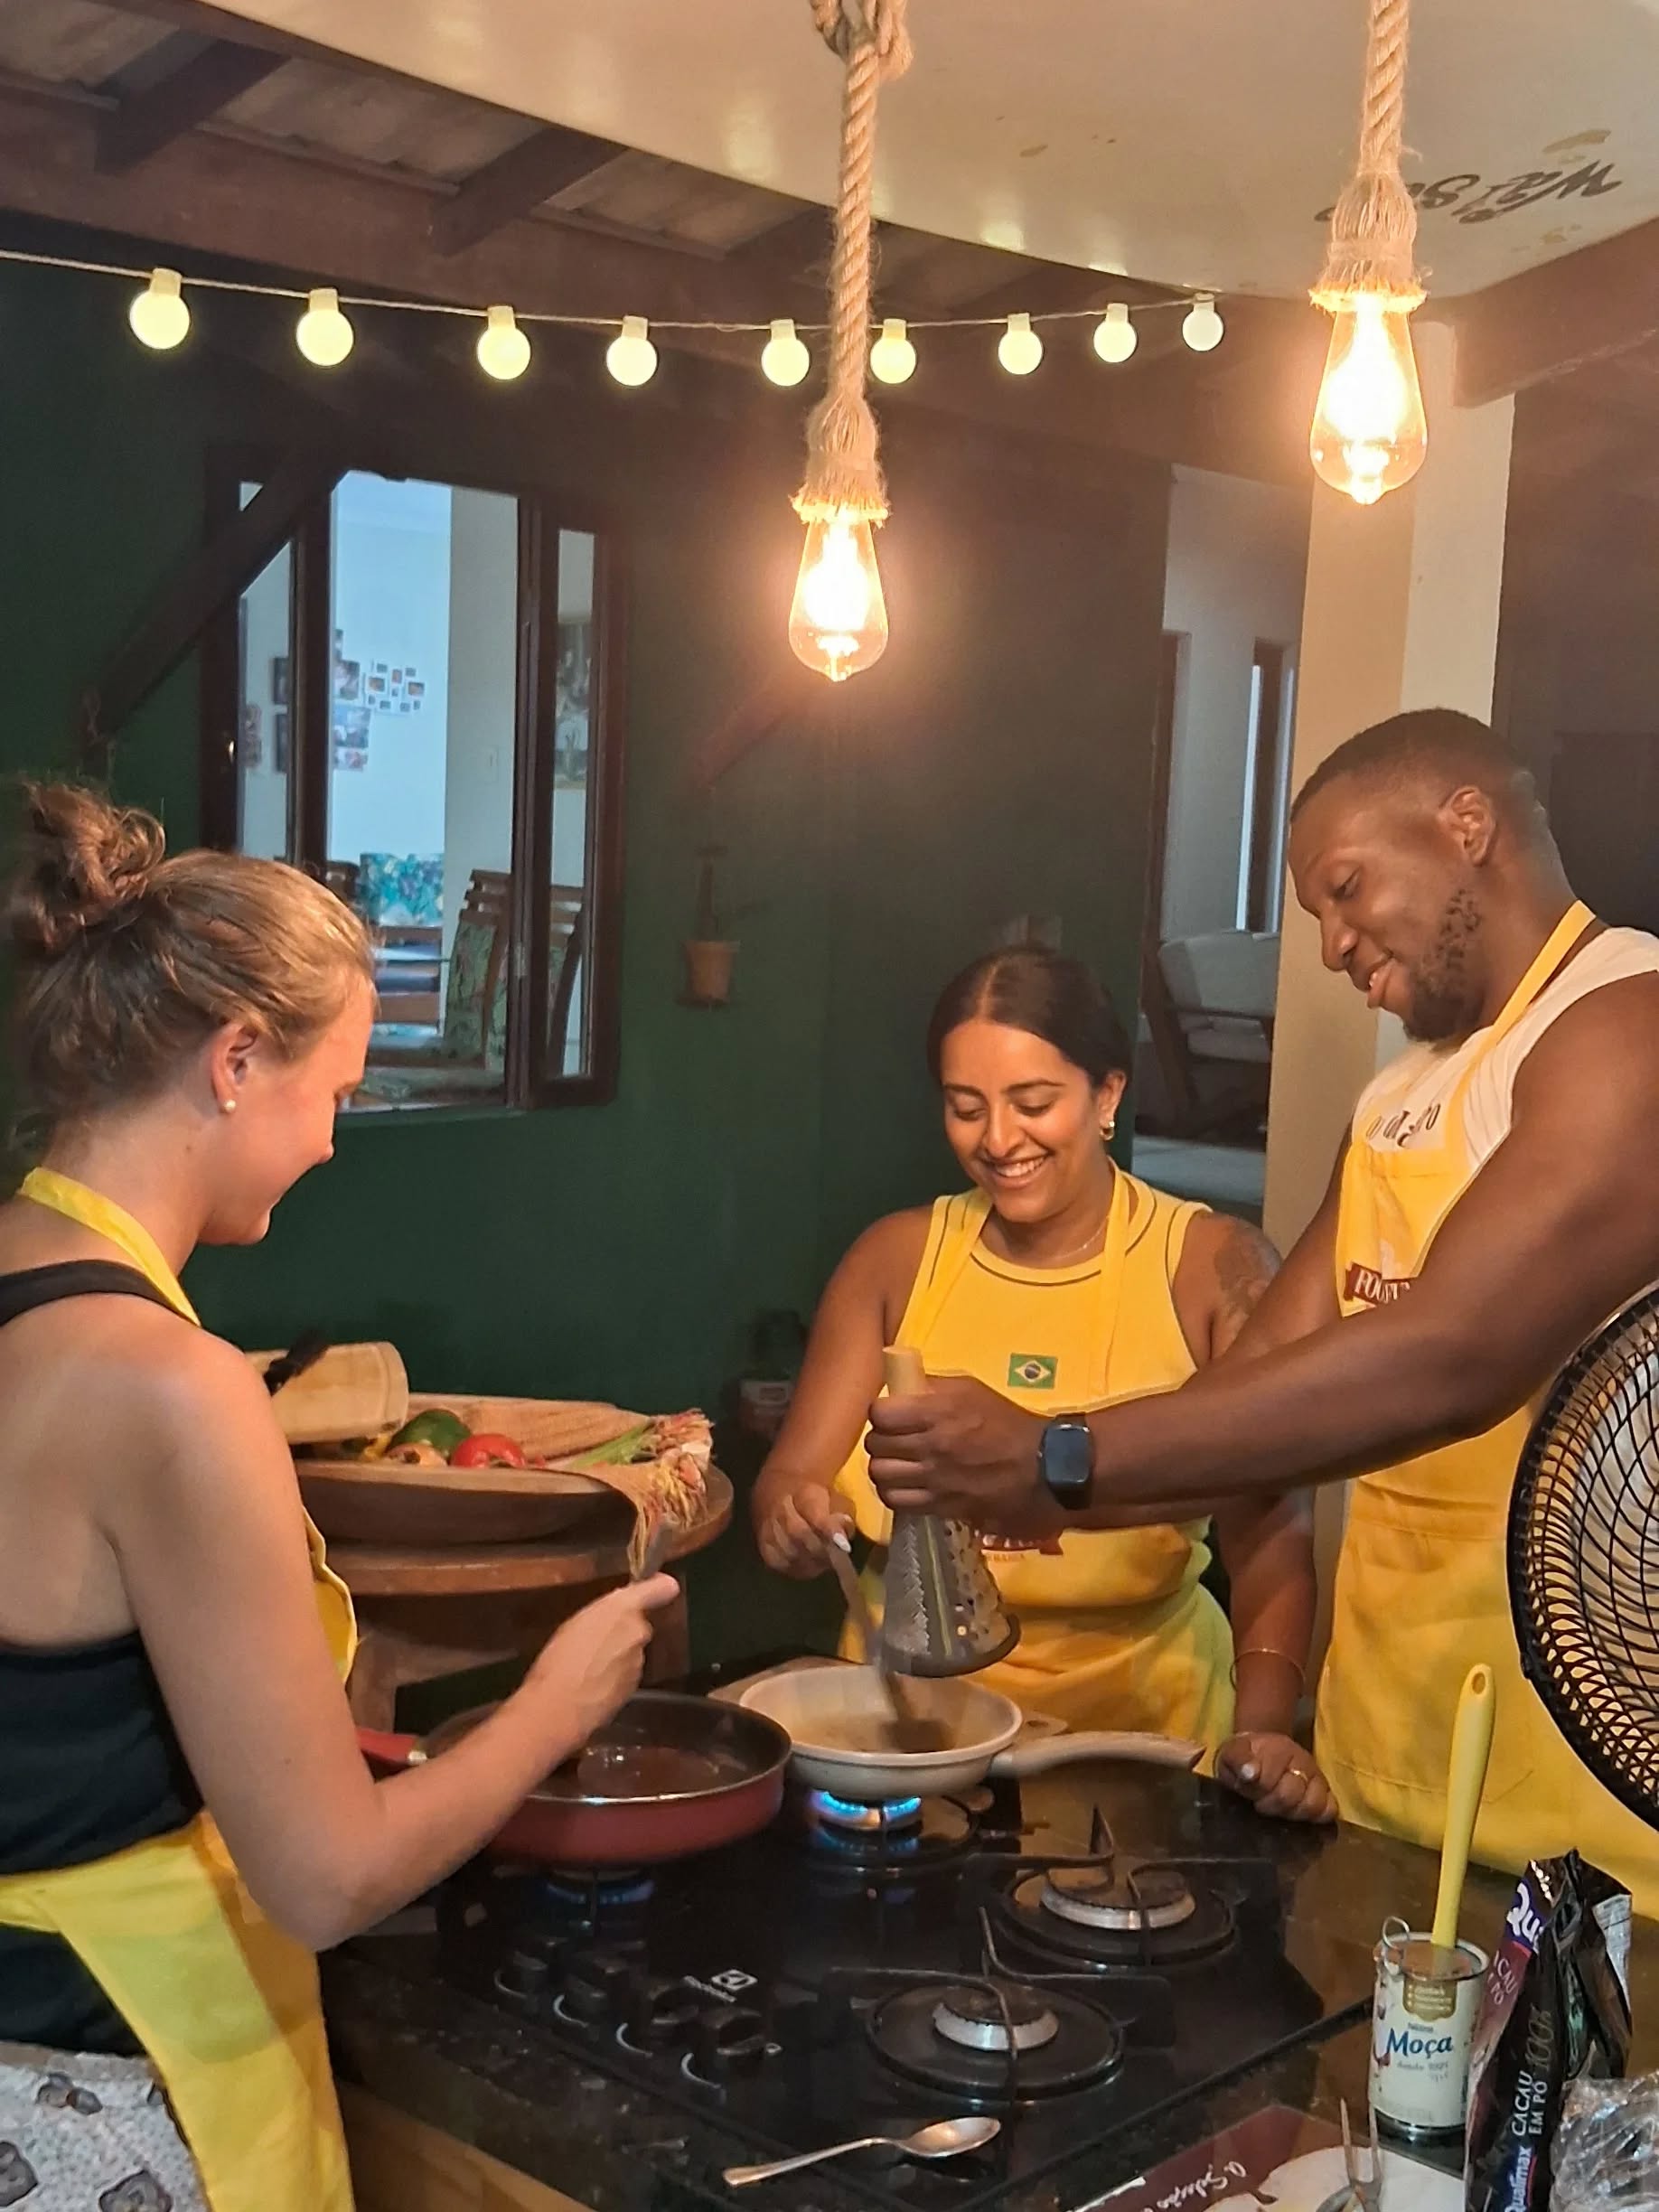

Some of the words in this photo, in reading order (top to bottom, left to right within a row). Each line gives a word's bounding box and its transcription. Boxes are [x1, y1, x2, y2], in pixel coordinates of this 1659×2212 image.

[1387, 2028, 1453, 2058] Moça
[1512, 2070, 1533, 2137] CACAU
[1532, 2080, 1548, 2104] PÓ
[1529, 2112, 1544, 2135] EM
